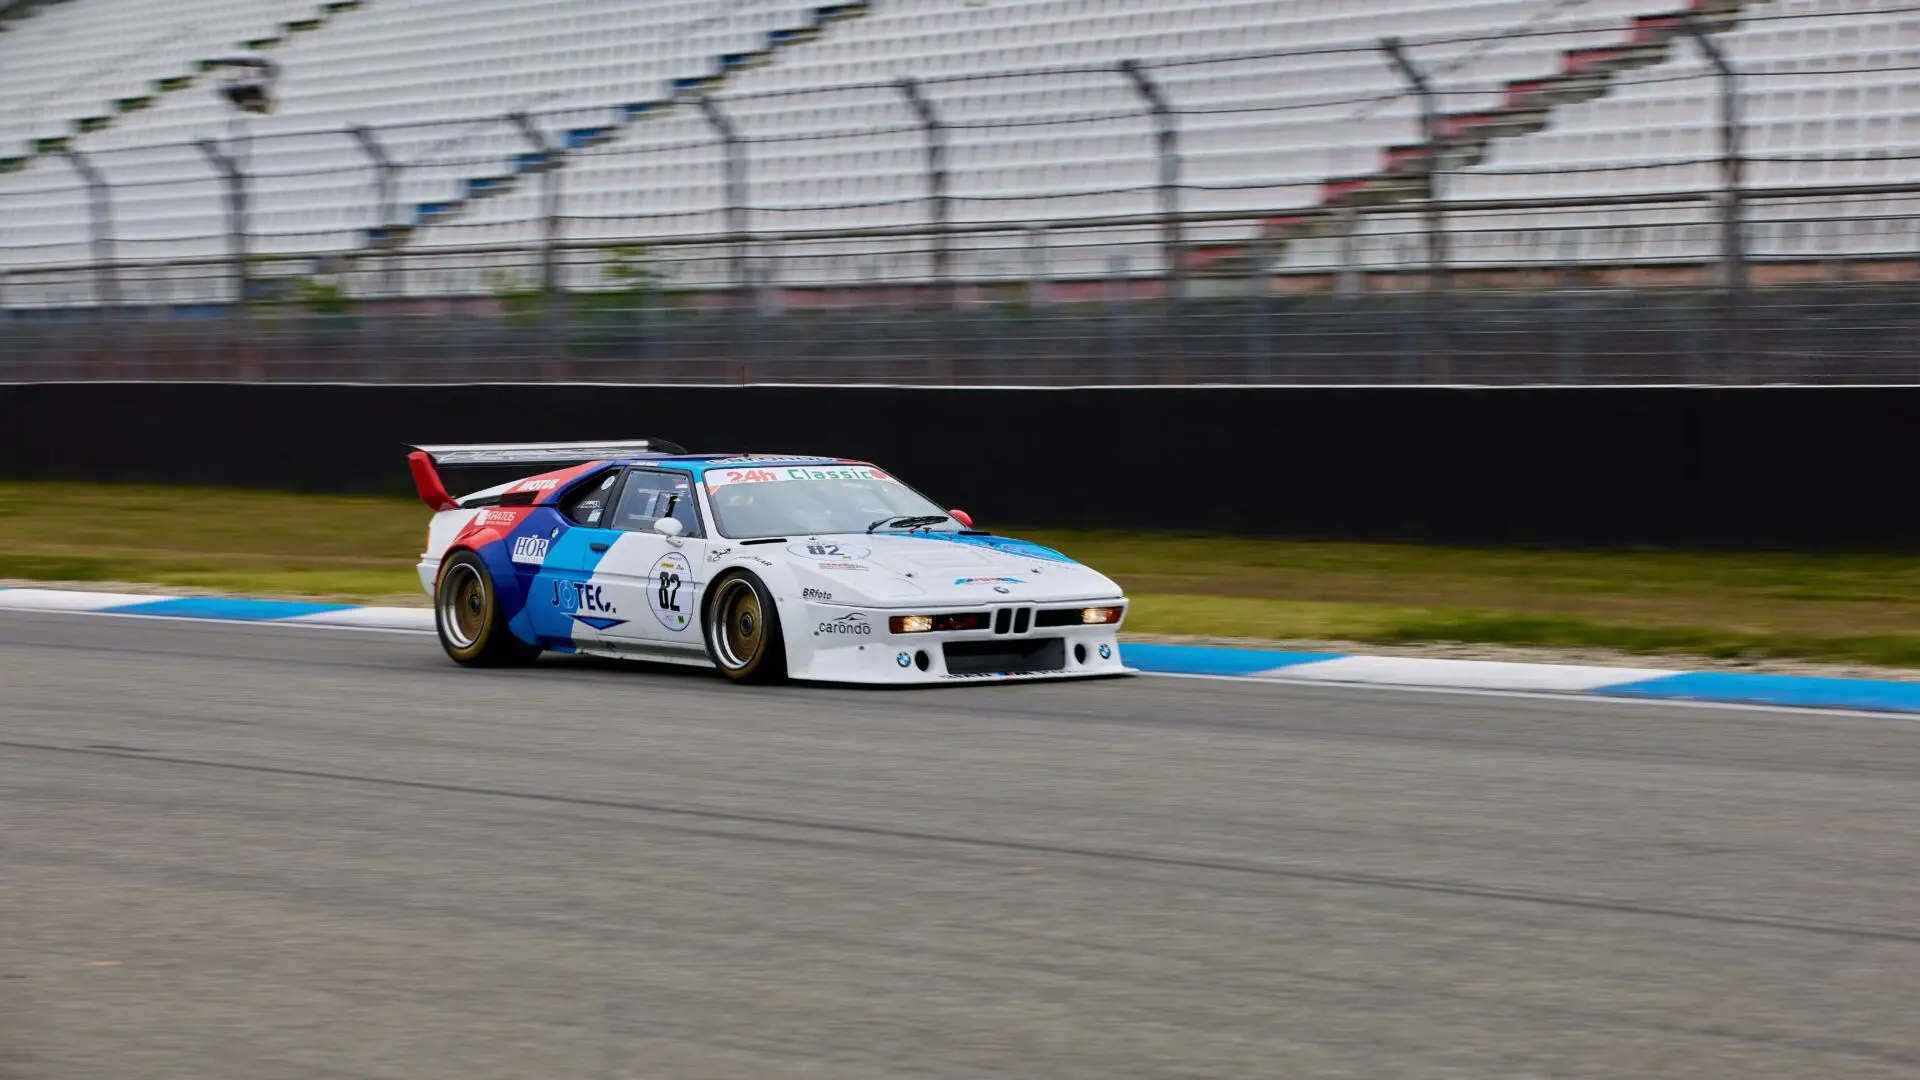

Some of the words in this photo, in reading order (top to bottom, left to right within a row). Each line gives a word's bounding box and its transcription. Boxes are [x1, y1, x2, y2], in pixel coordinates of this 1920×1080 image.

[726, 469, 778, 483] 24h
[787, 468, 869, 480] Classic
[515, 534, 546, 558] HÖR
[806, 544, 845, 556] 82
[659, 571, 681, 612] 82
[802, 587, 832, 600] BRfoto
